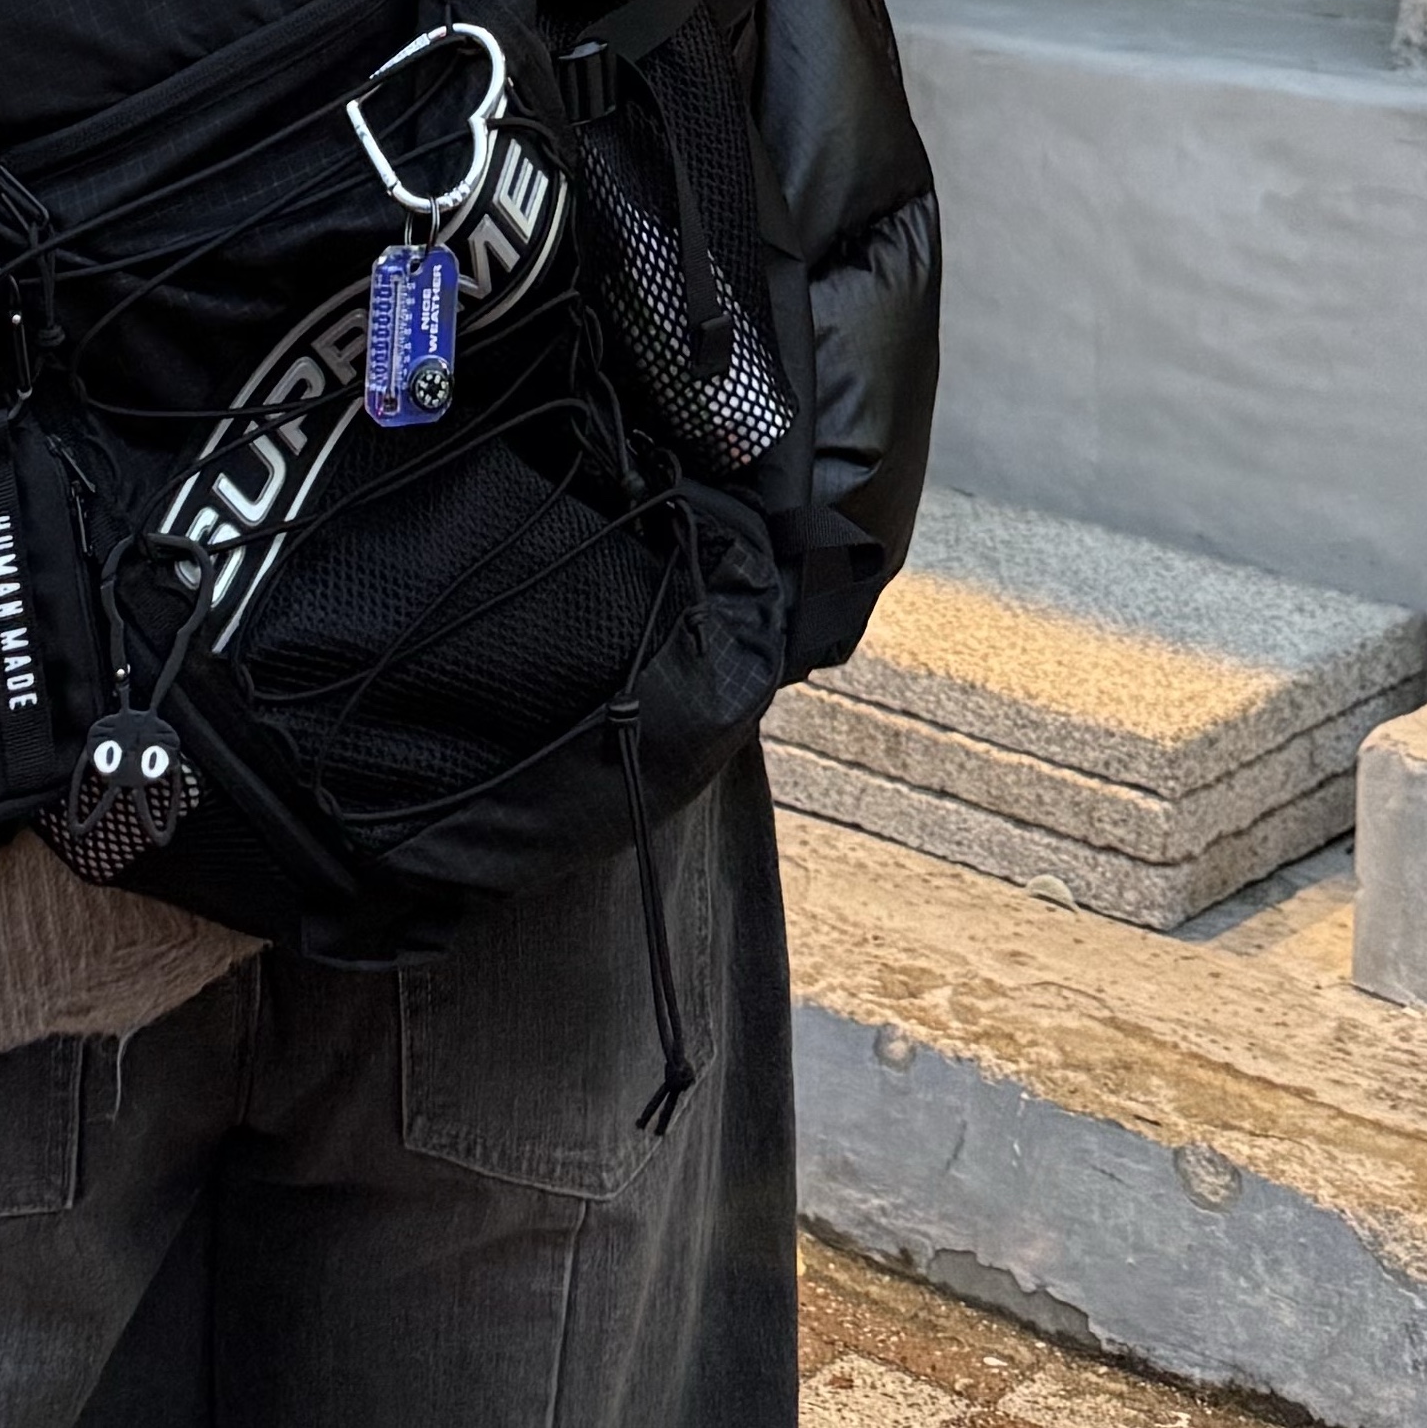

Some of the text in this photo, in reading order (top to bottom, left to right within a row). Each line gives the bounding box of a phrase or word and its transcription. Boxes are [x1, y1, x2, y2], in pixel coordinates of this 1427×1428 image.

[421, 288, 432, 331] NICE
[428, 264, 443, 354] WEATHER
[0, 627, 38, 710] MADE
